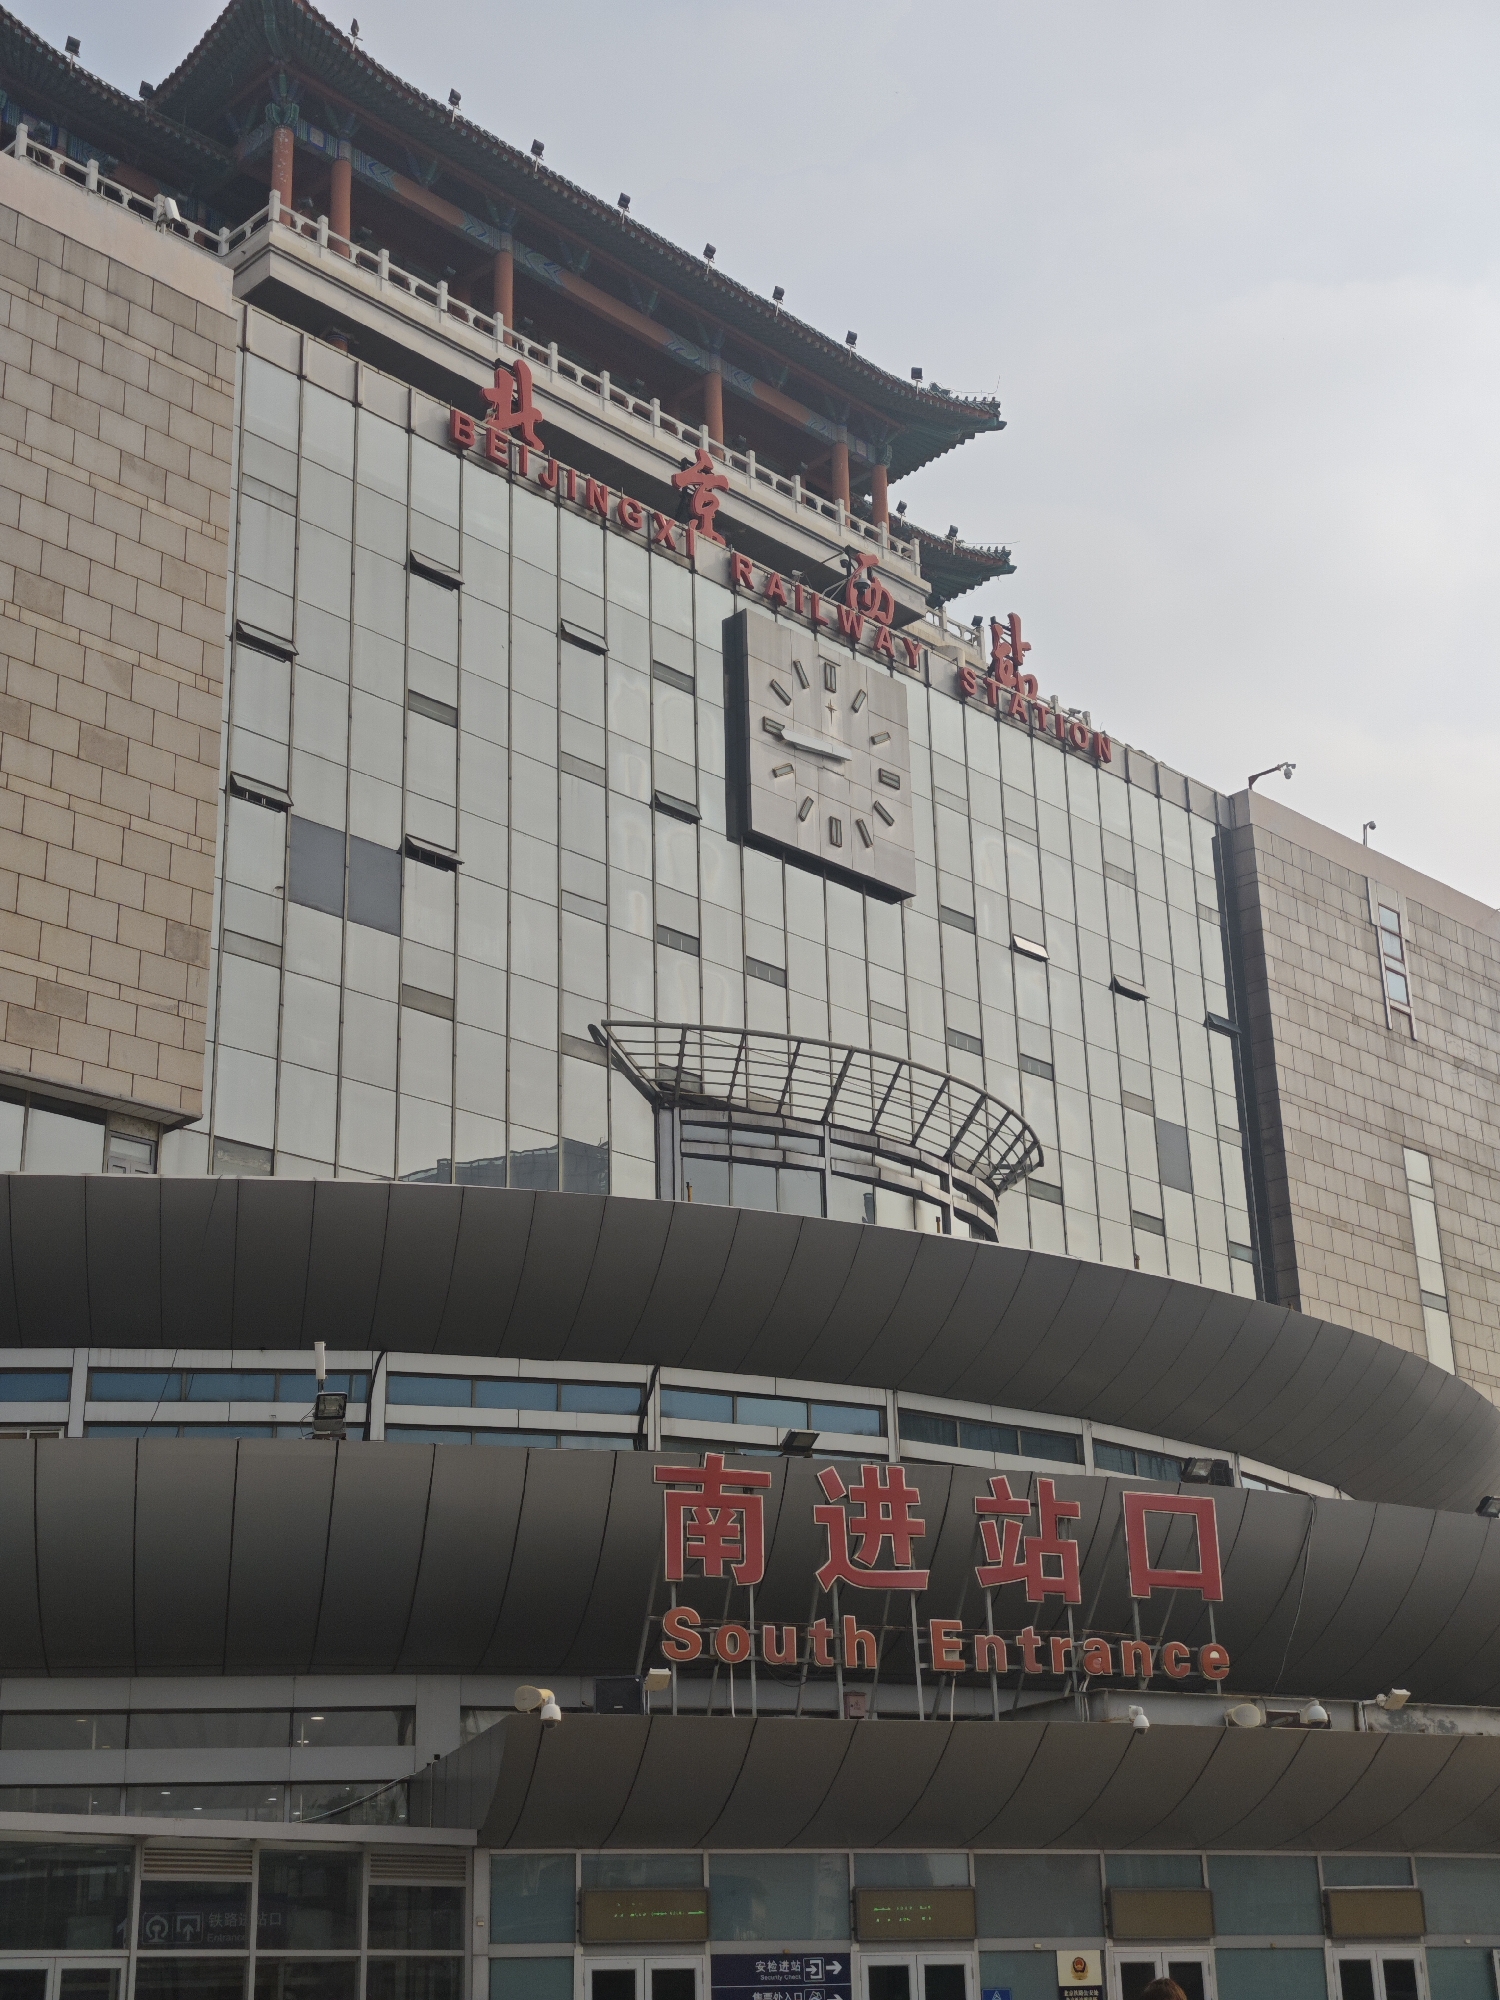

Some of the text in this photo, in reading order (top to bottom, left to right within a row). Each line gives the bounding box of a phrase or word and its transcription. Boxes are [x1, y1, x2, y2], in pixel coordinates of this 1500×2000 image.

[450, 408, 1112, 763] BEIJINGXI RAILWAY STATION
[480, 359, 1039, 700] 北京西站
[653, 1452, 1224, 1604] 南进站口
[661, 1605, 1231, 1681] South Entrance
[755, 1959, 801, 1973] 安检进站
